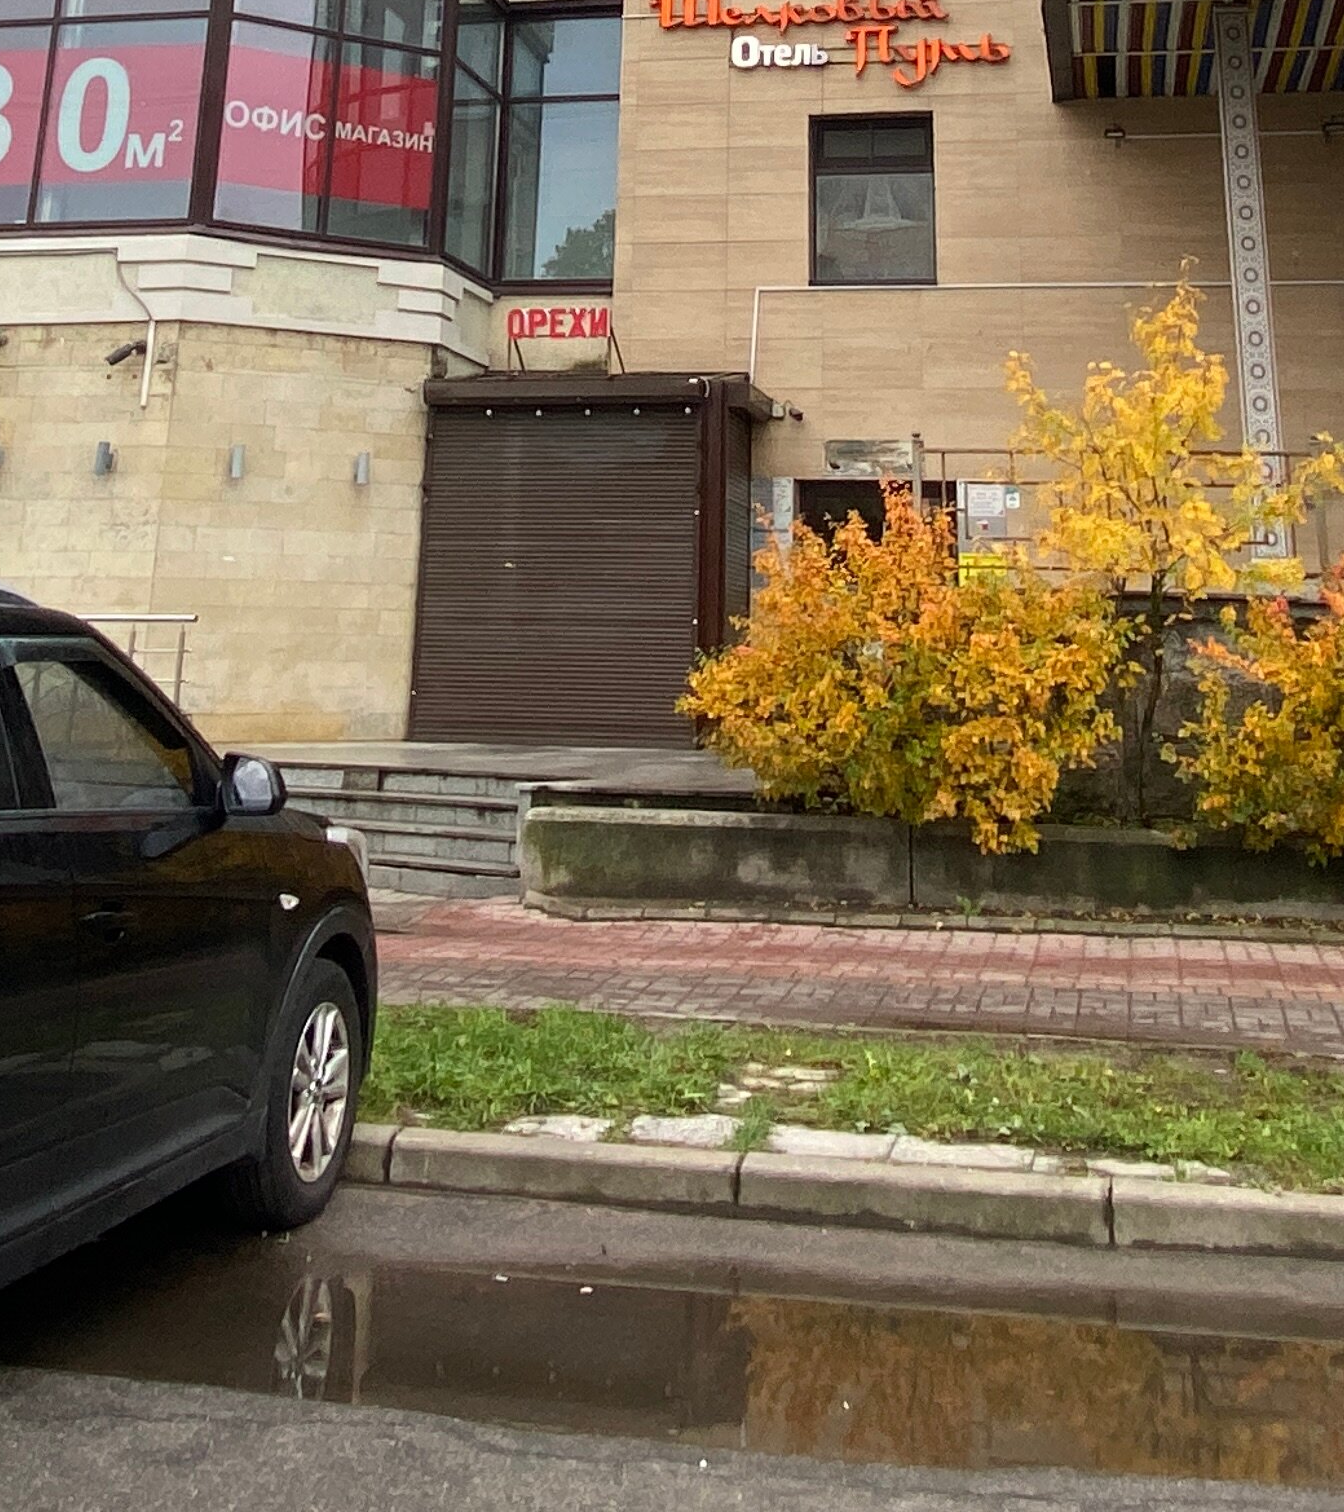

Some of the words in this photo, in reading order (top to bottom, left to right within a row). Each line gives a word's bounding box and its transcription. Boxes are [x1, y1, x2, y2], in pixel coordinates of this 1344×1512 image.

[731, 35, 828, 69] Отель
[845, 25, 1012, 86] Путь
[224, 100, 327, 142] ОФИС
[335, 121, 434, 154] МАГАЗИН
[507, 307, 609, 340] ОРЕХИ
